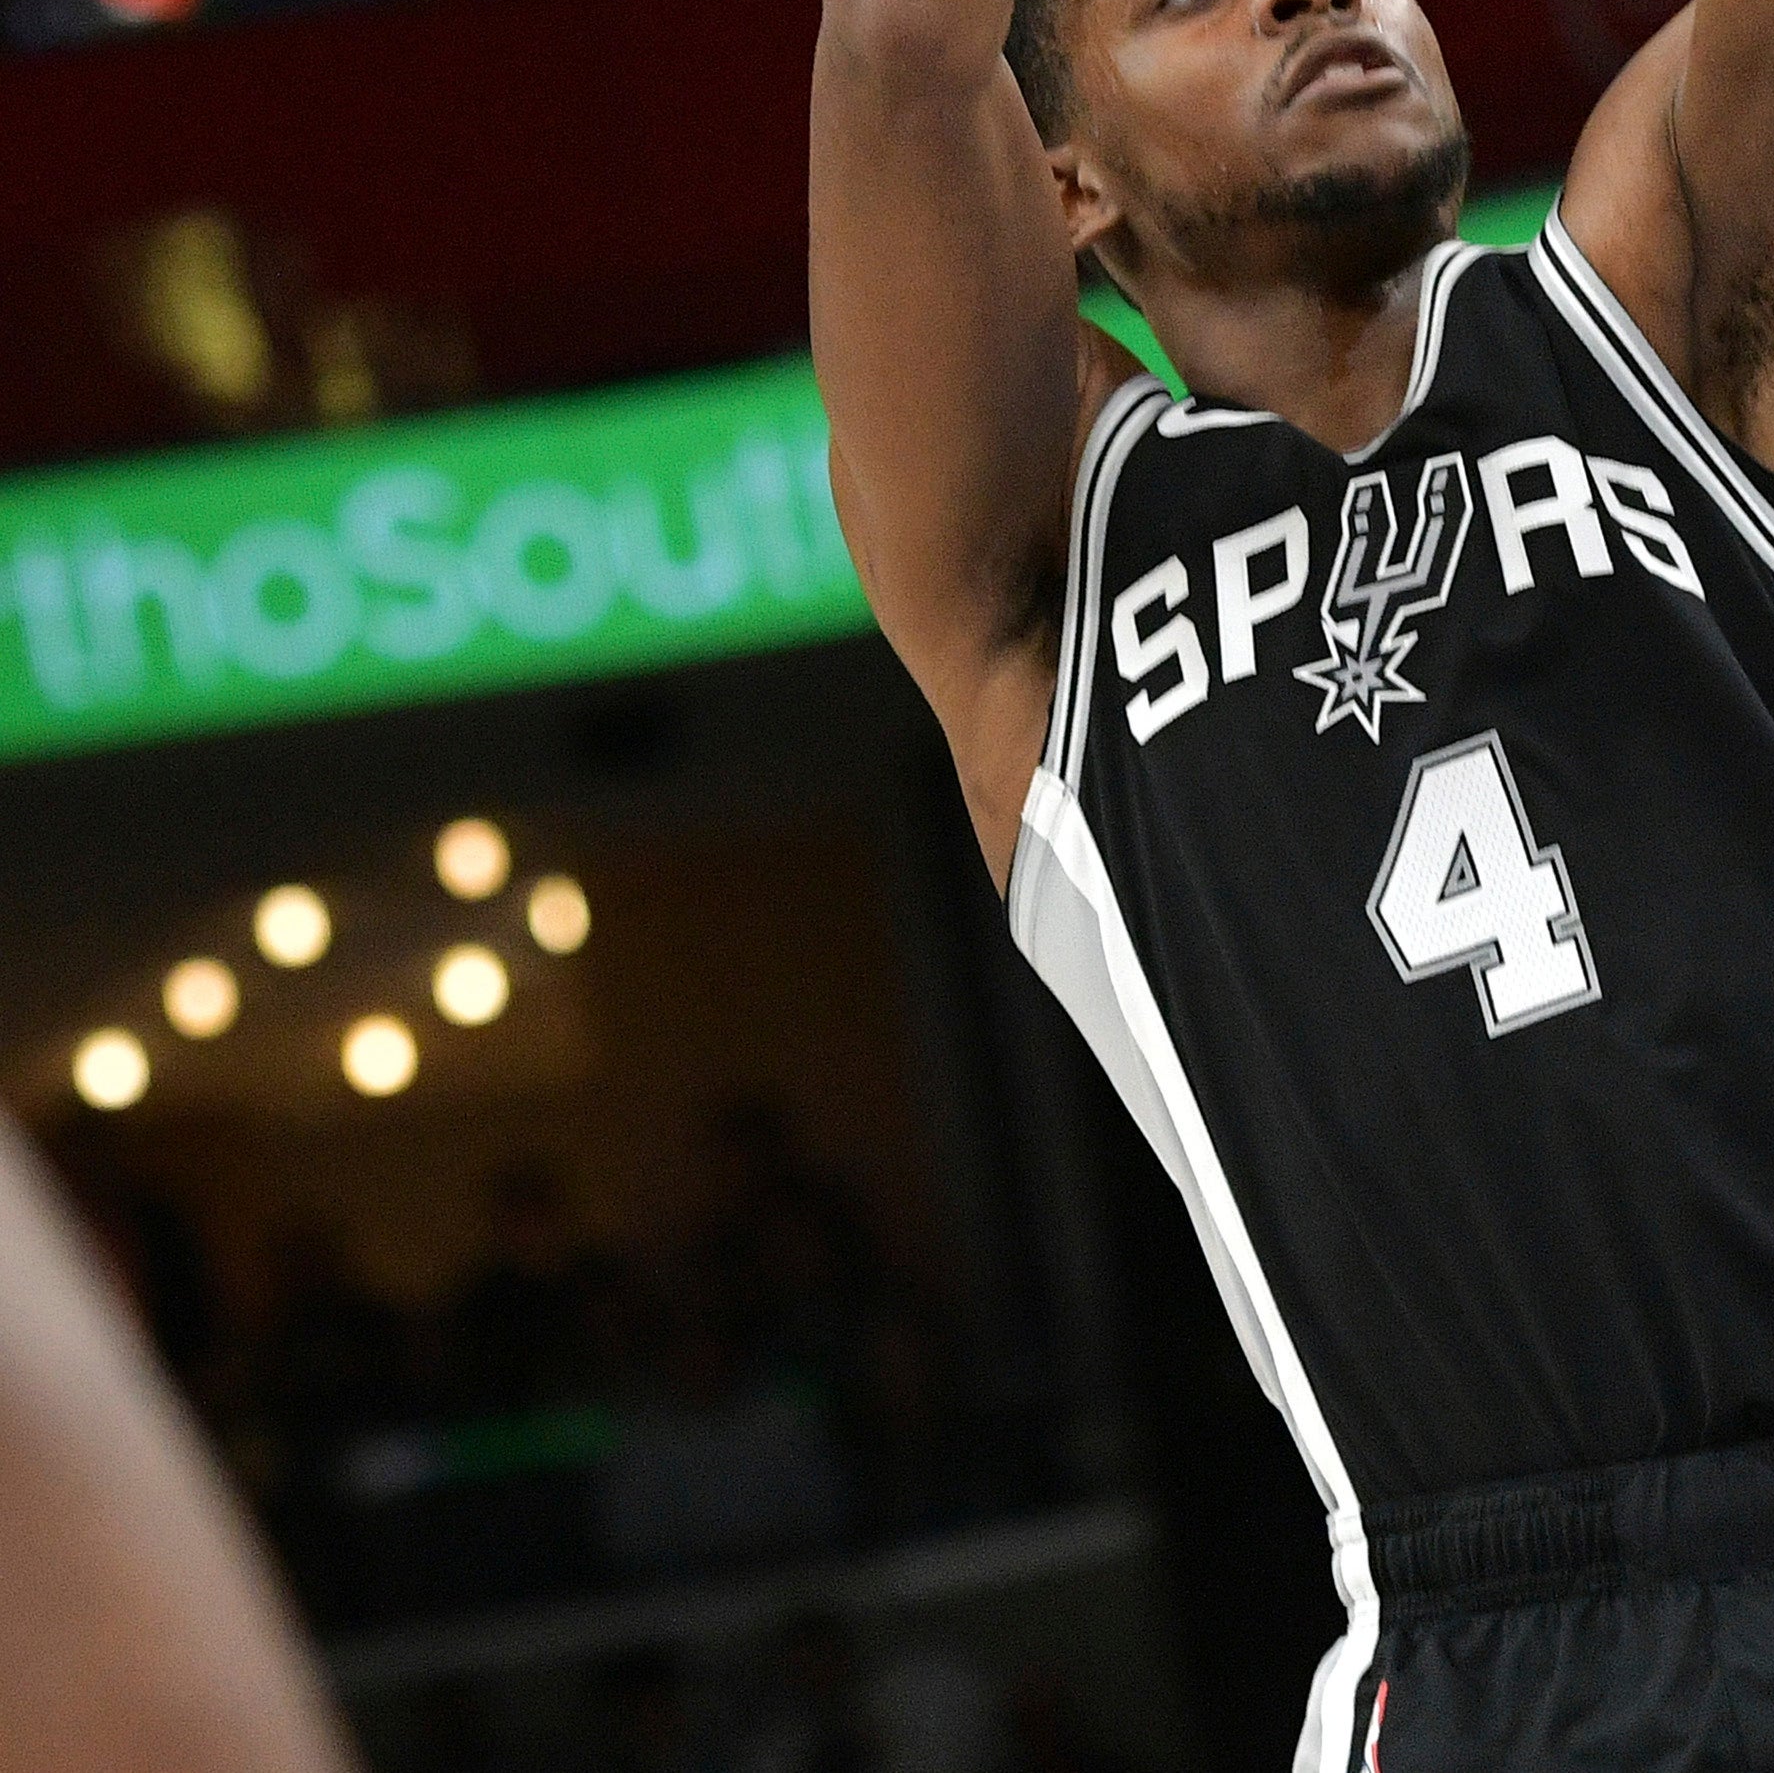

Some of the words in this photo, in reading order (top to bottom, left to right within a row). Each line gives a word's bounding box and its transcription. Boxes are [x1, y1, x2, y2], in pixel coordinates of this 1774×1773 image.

[0, 424, 850, 713] thoSout
[1111, 435, 1705, 745] SPURS
[1366, 729, 1602, 1039] 4
